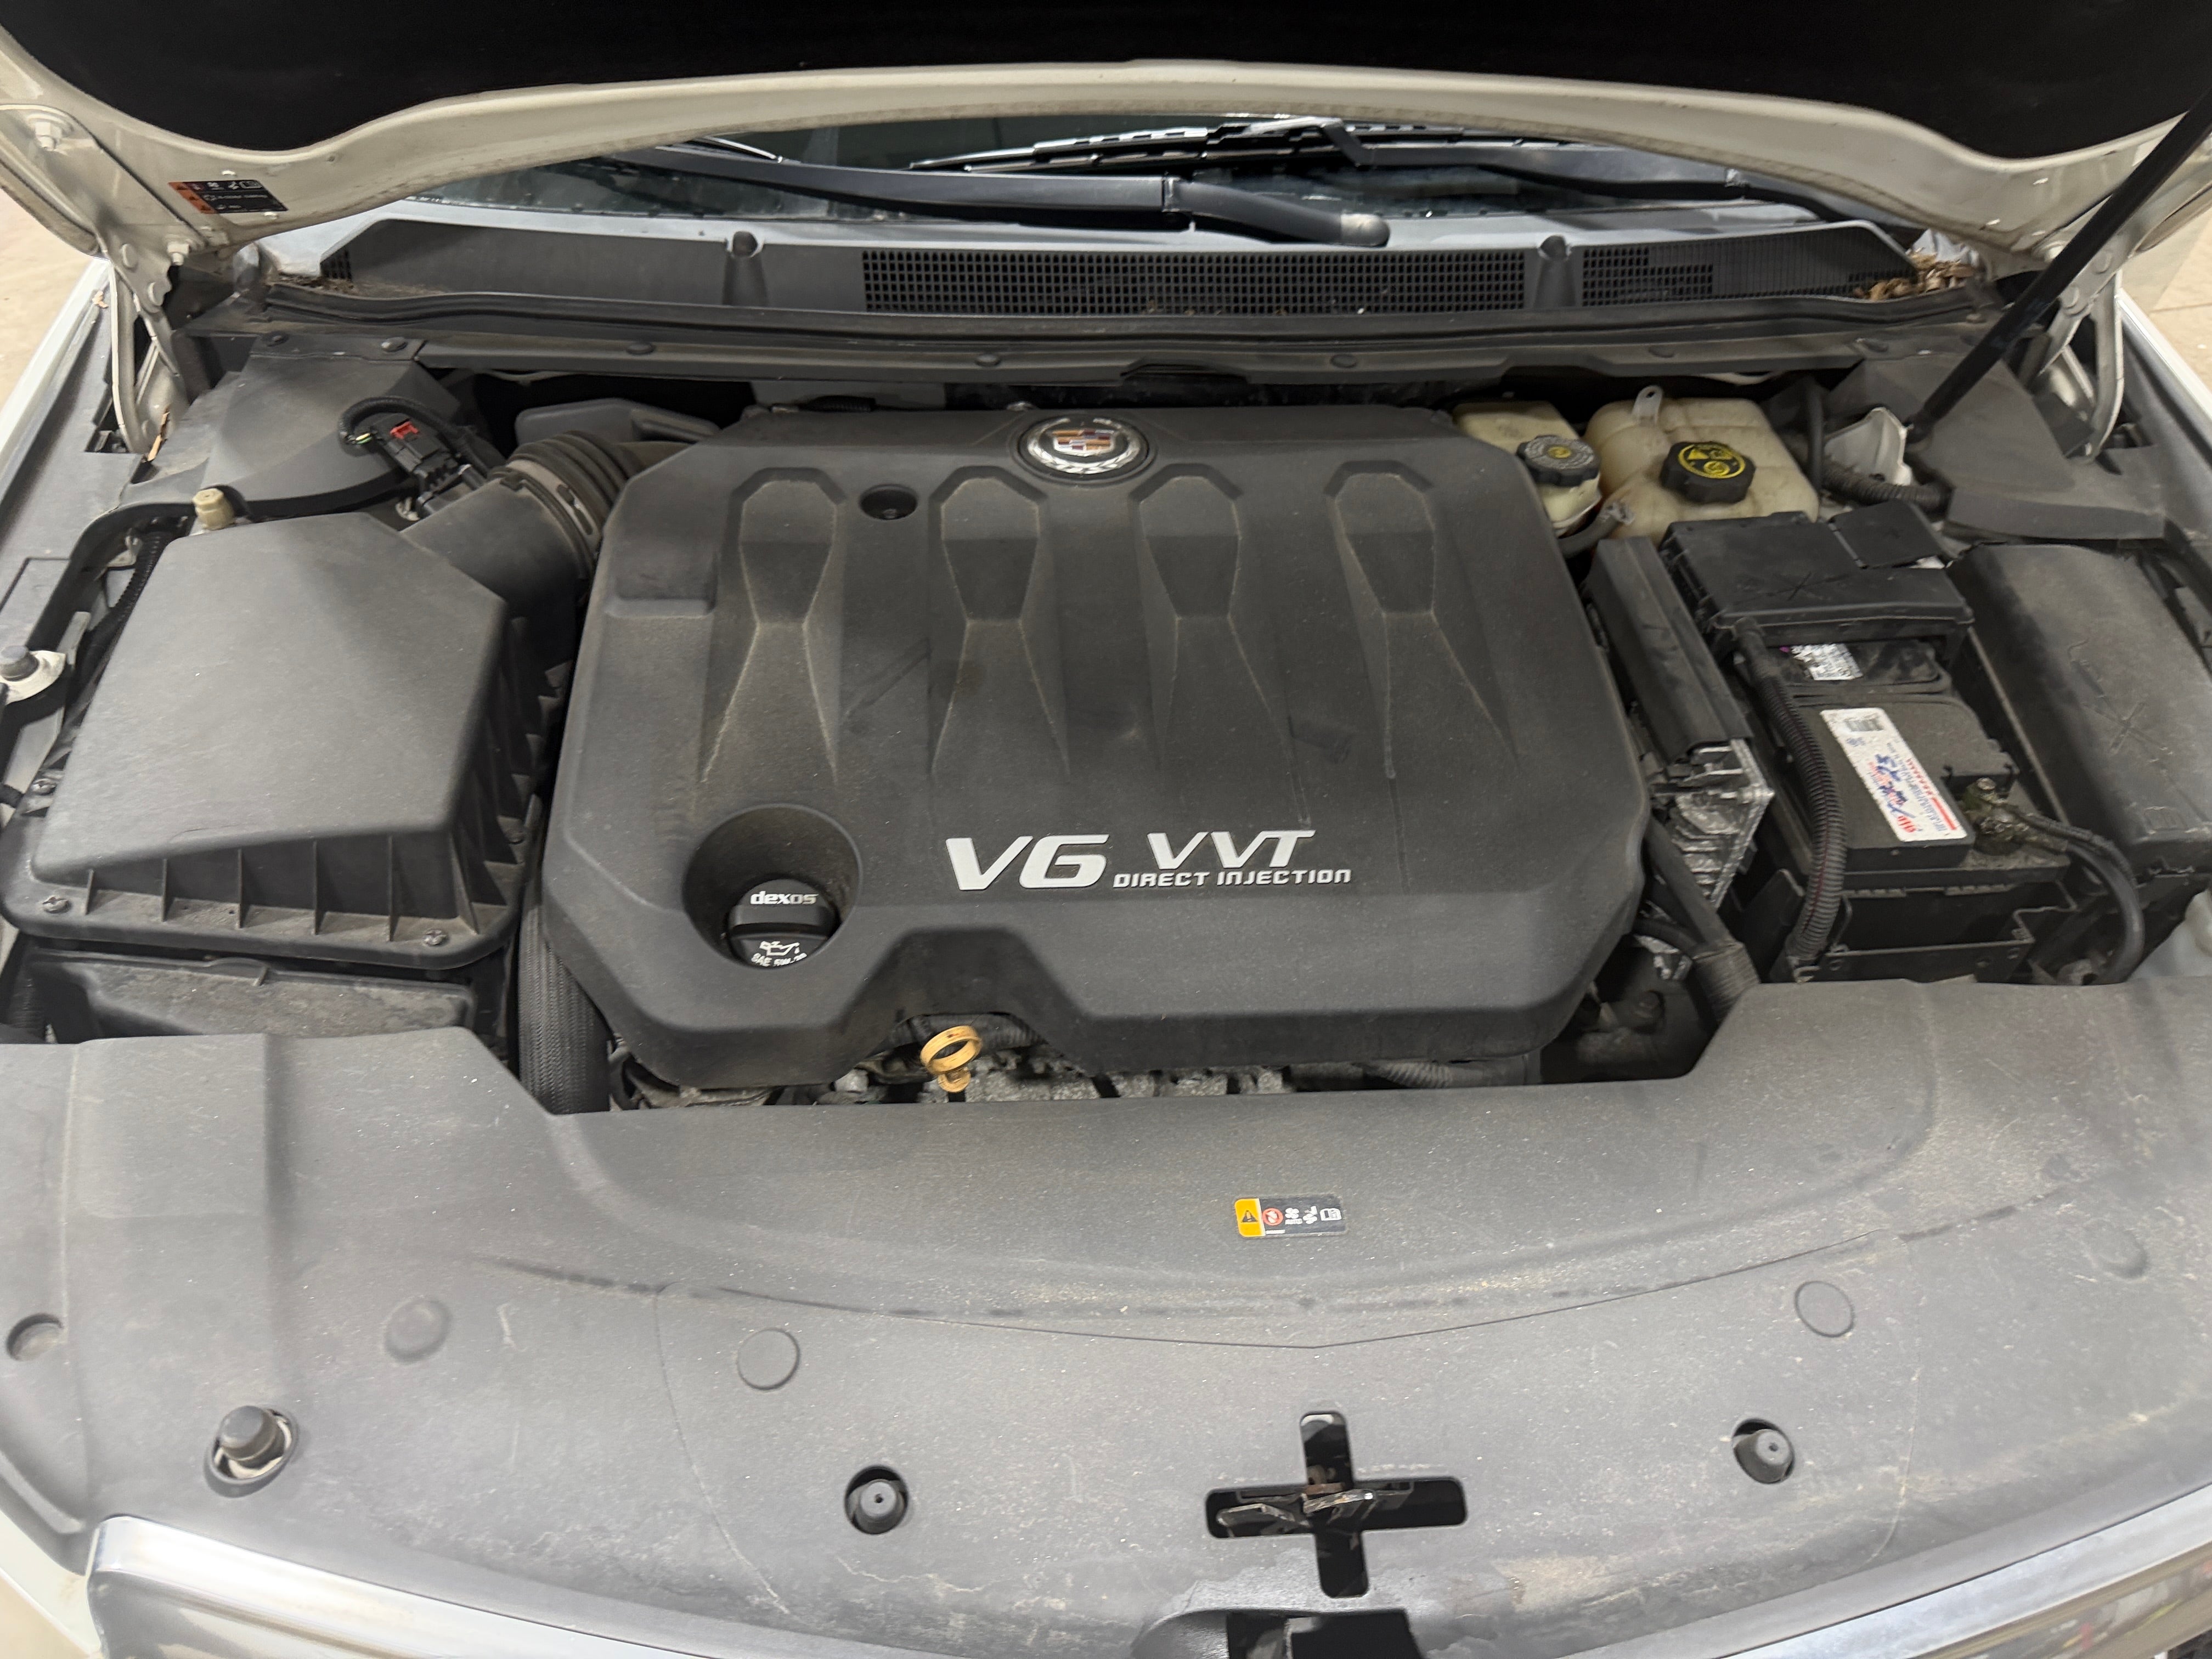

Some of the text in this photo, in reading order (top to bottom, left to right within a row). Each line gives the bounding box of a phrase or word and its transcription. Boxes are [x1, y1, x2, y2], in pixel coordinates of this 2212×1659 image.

[945, 830, 1316, 890] V6 VVT
[1112, 868, 1352, 888] DIRECT INJECTION
[750, 890, 819, 905] dexos
[751, 952, 772, 967] SAE
